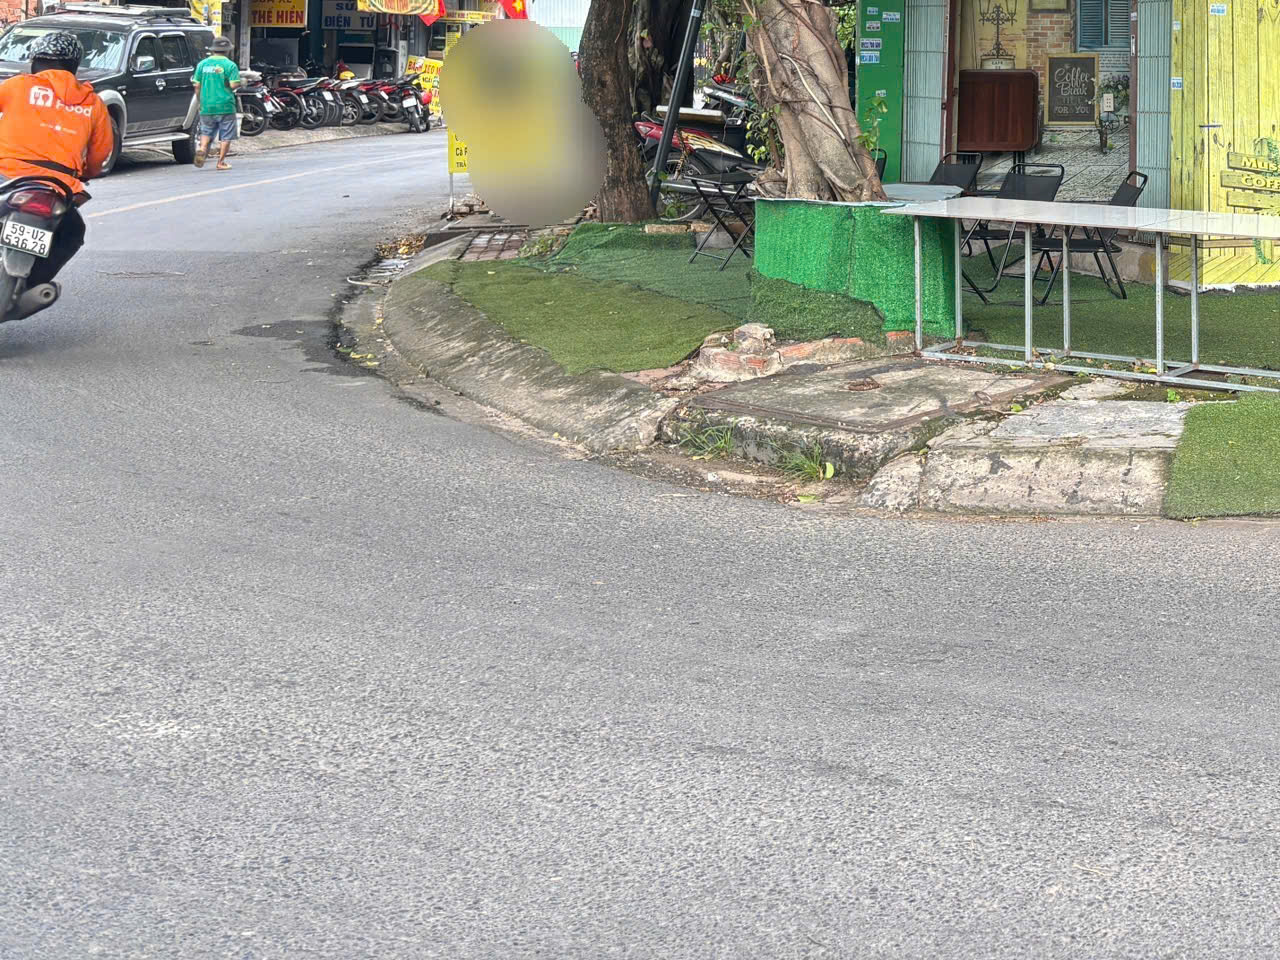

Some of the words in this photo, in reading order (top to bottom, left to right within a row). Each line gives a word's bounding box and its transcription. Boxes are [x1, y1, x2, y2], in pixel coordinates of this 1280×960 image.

[251, 7, 273, 24] THẾ
[276, 4, 304, 24] HIỂN
[360, 12, 376, 28] TỬ
[1054, 67, 1090, 88] Coffee
[1055, 82, 1088, 96] Break
[5, 234, 47, 256] 536.28
